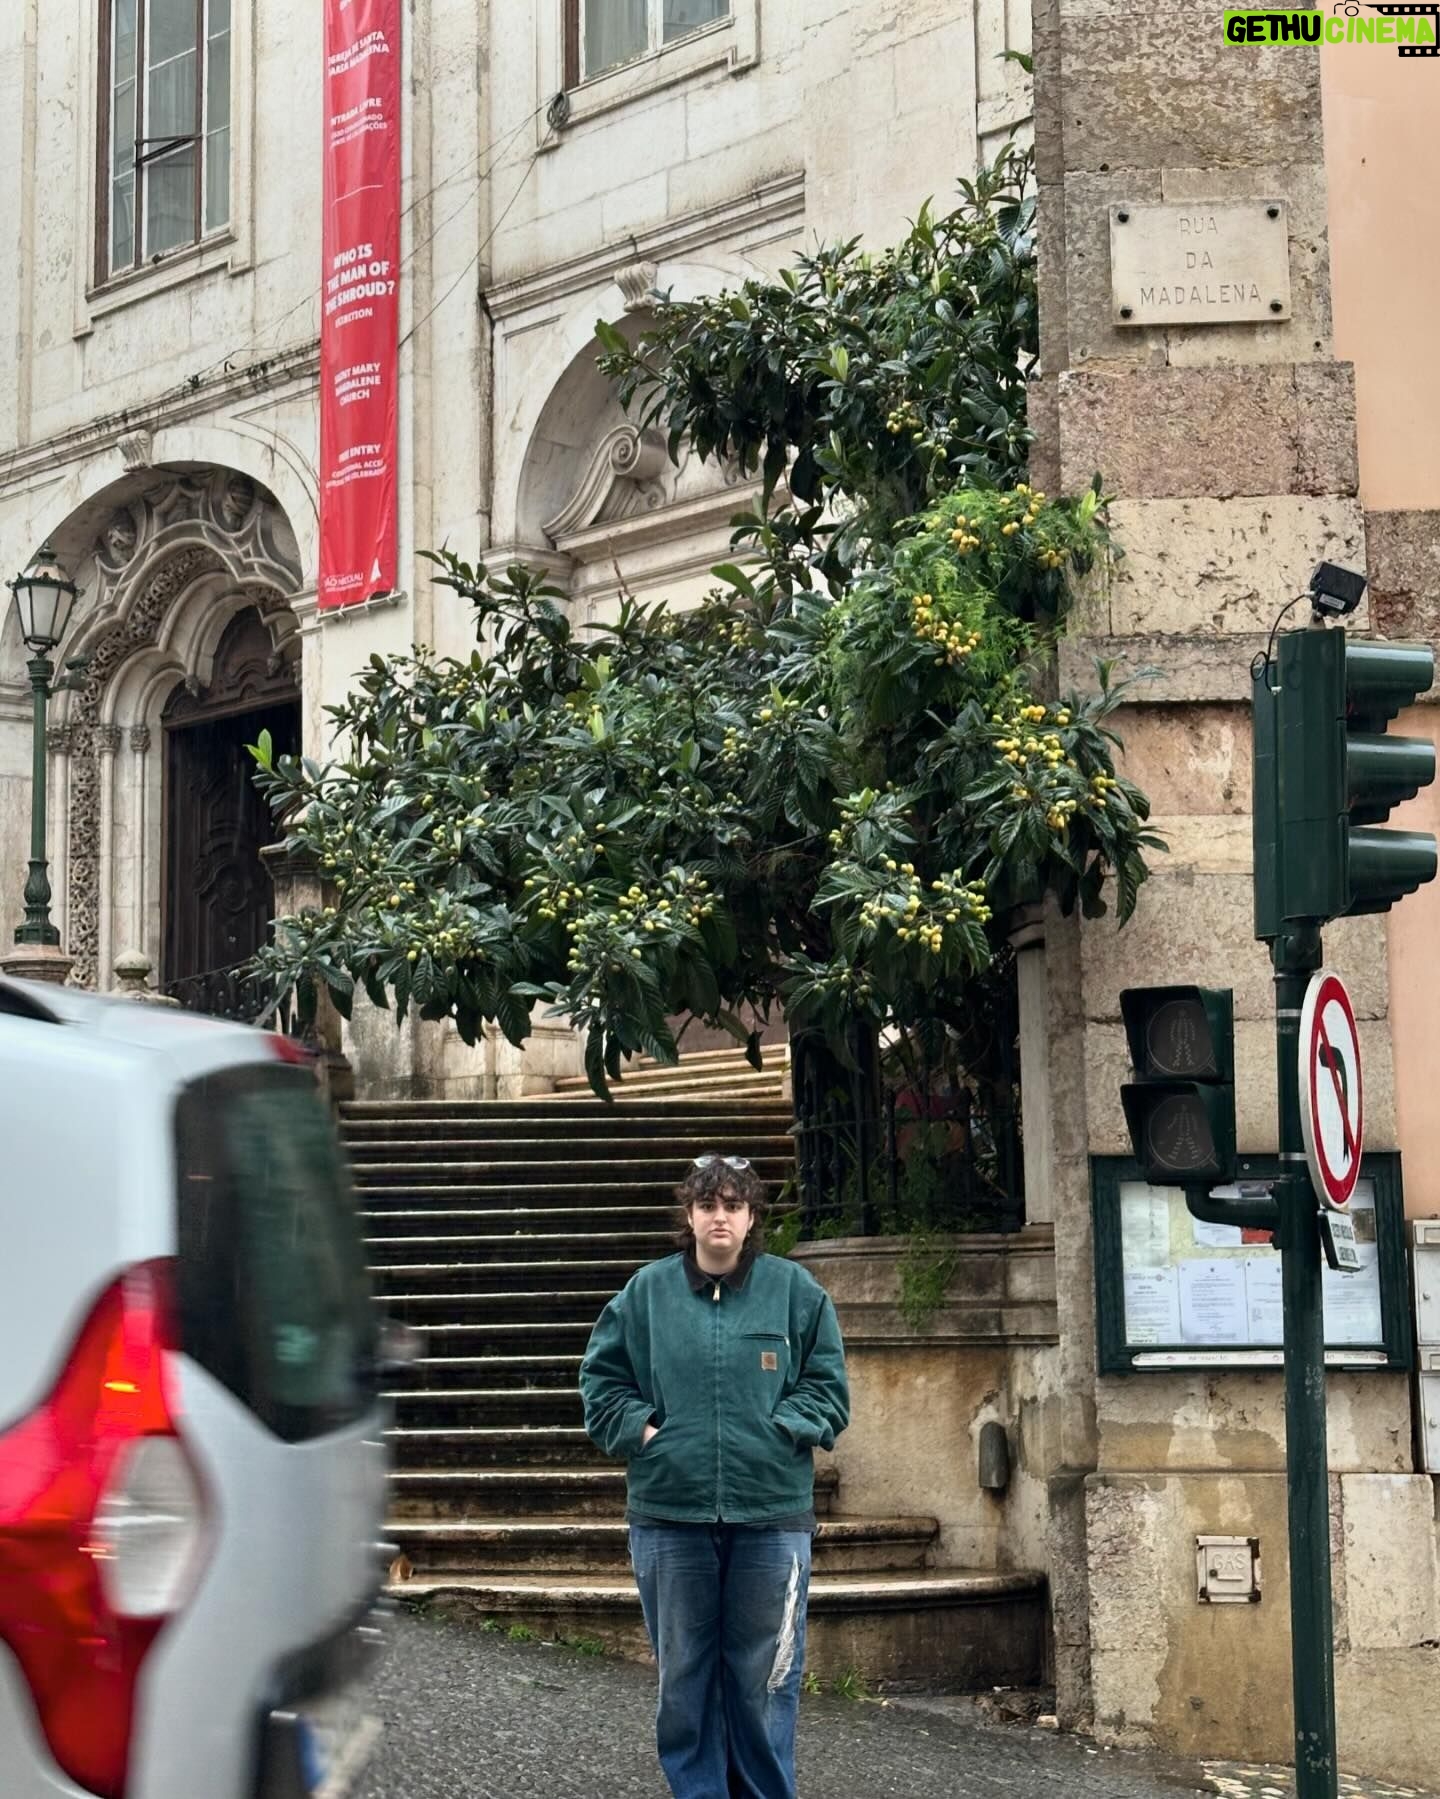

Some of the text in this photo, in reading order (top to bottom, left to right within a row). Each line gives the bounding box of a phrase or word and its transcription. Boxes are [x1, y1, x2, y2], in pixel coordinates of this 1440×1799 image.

[1179, 217, 1219, 236] RUA
[333, 243, 373, 270] WHO IS
[1185, 251, 1214, 270] DA
[340, 263, 367, 286] MAN
[369, 260, 390, 277] OF
[337, 280, 396, 307] SHROUD?
[1140, 284, 1262, 306] MADALENA
[352, 362, 381, 376] MARY
[350, 443, 381, 458] ENTRY
[1214, 1552, 1247, 1571] GAS
